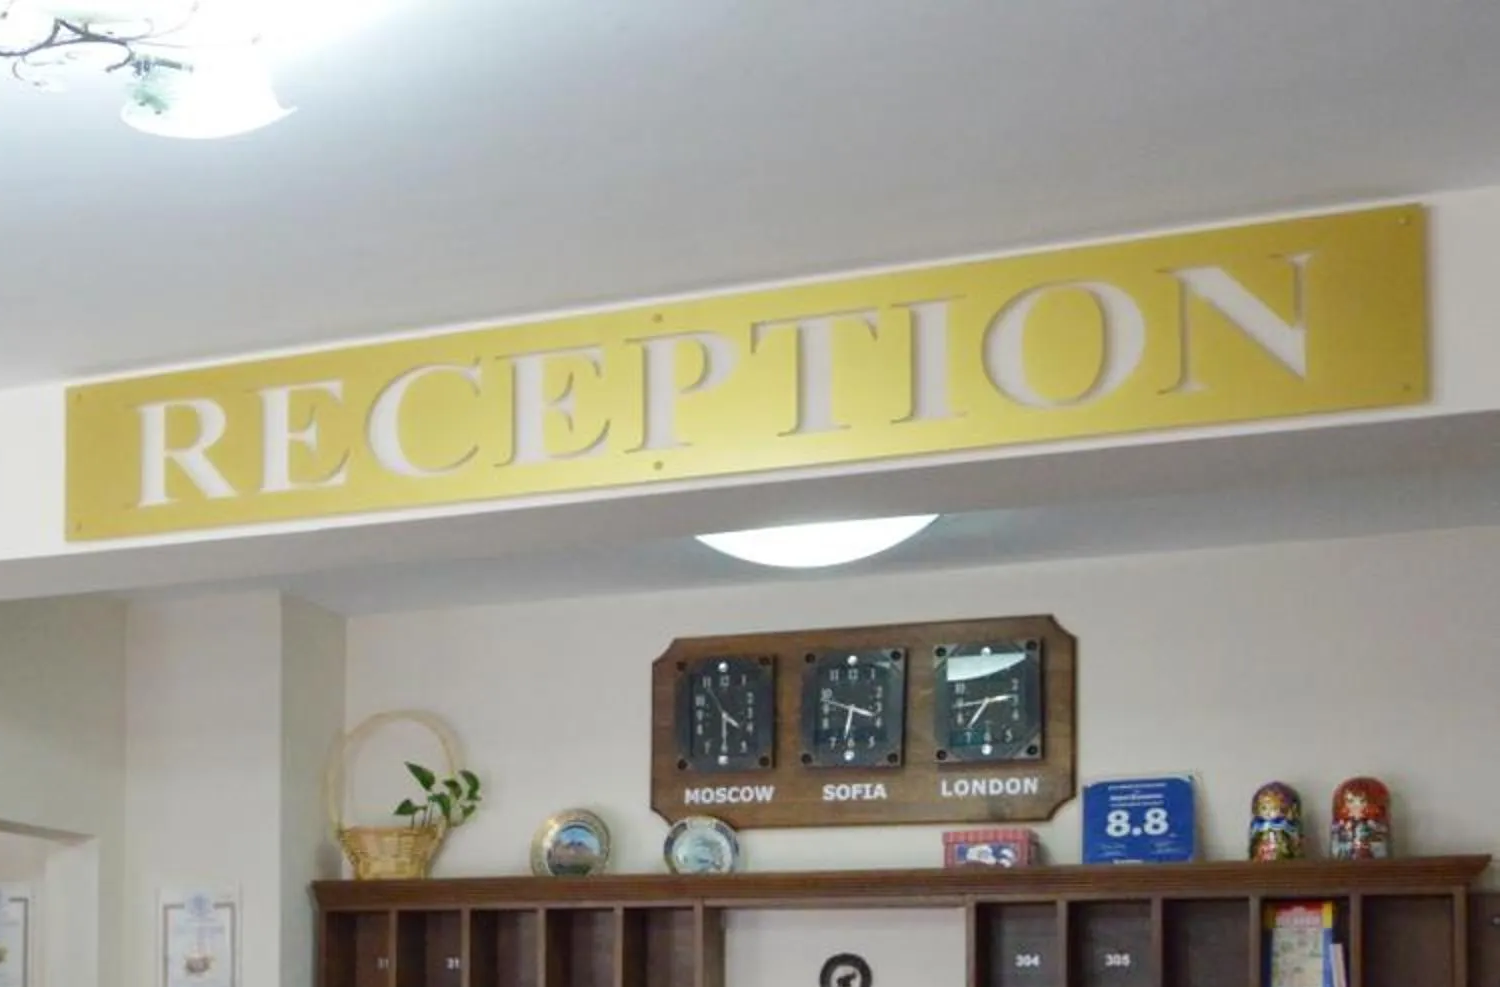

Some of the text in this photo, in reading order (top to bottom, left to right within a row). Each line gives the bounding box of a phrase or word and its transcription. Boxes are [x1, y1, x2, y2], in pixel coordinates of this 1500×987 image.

[135, 250, 1322, 510] RECEPTION
[683, 784, 776, 805] MOSCOW
[821, 782, 889, 801] SOFIA
[940, 776, 1040, 797] LONDON
[1105, 808, 1170, 838] 8.8
[1014, 953, 1041, 968] 304
[1104, 952, 1132, 967] 305
